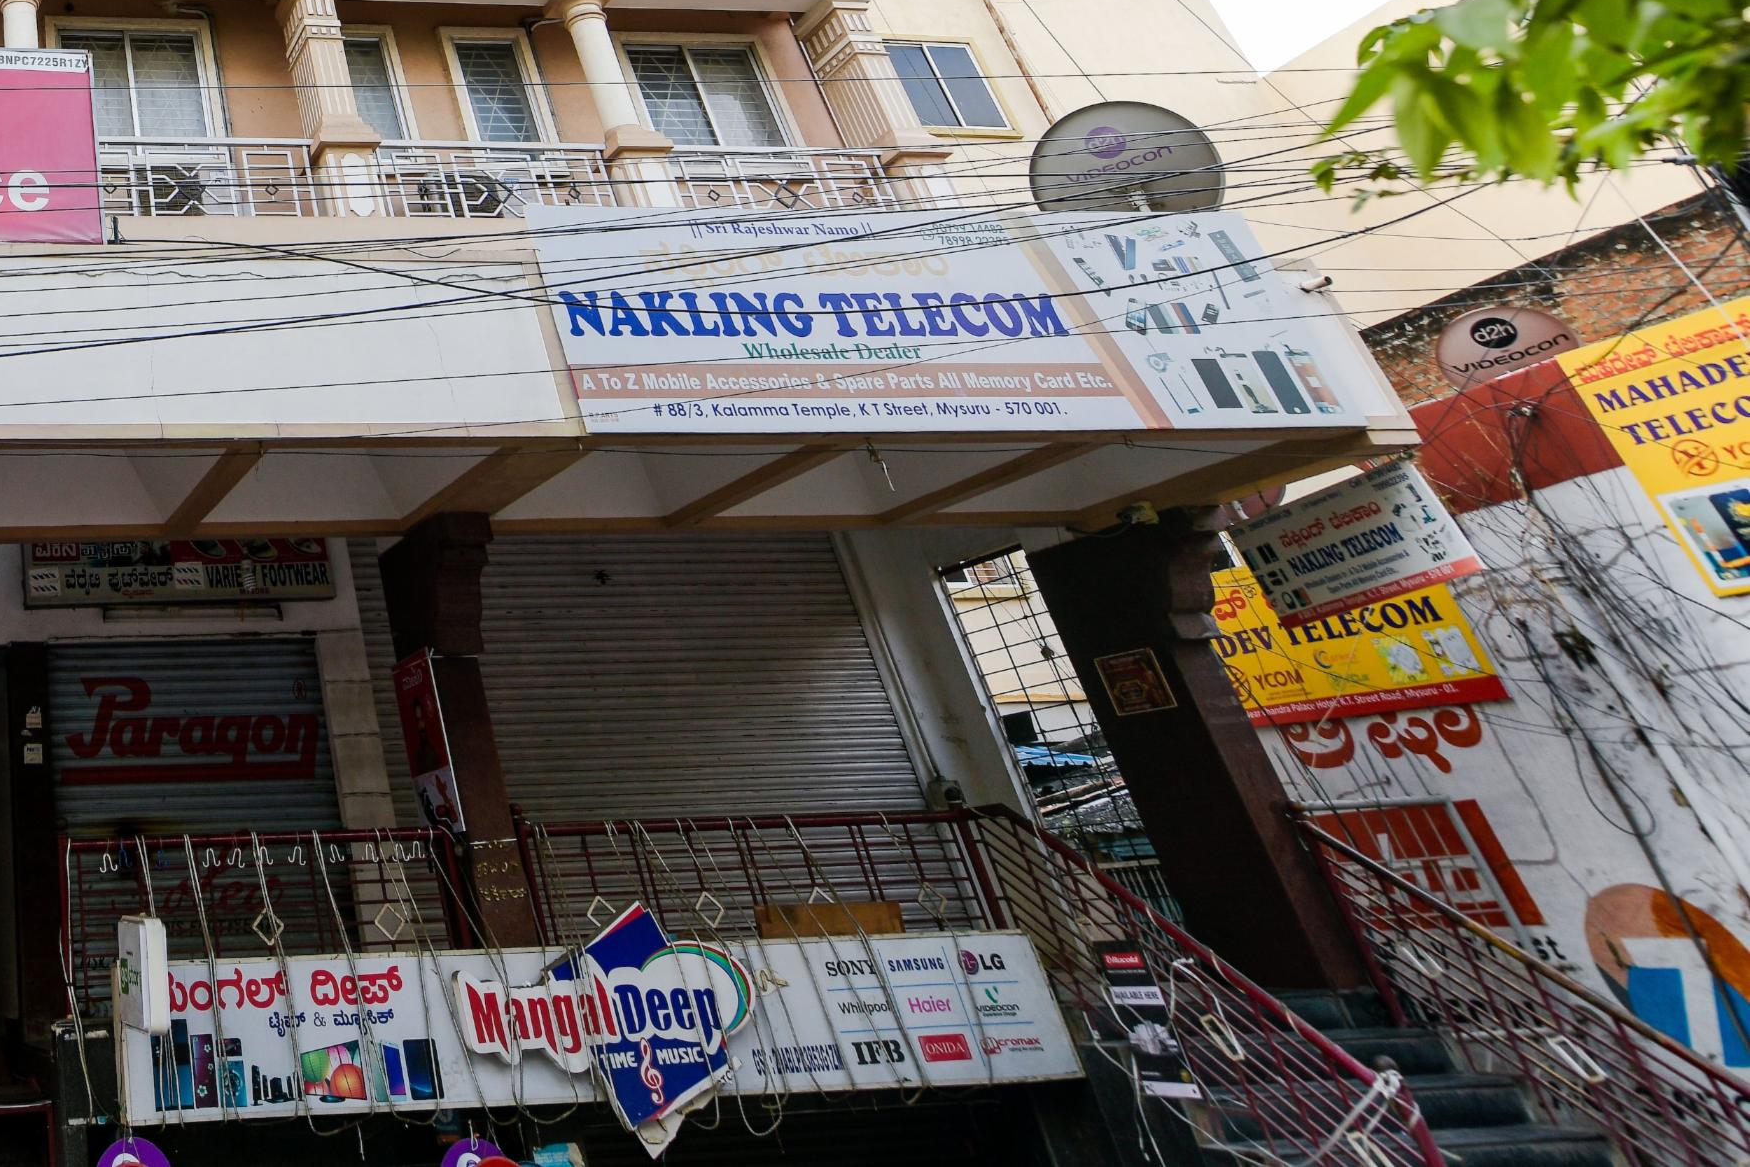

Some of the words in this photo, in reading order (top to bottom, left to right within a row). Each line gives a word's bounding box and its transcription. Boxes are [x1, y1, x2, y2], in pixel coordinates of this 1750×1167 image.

[706, 222, 730, 235] Sri
[732, 221, 810, 239] Rajeshwar
[812, 222, 859, 236] Namo
[558, 289, 817, 339] NAKLING
[818, 290, 1072, 339] TELECOM
[1472, 323, 1515, 343] d2h
[741, 342, 851, 361] Wholesale
[854, 342, 922, 360] Dealer
[1451, 333, 1570, 374] VIDEOCON
[582, 373, 596, 390] A
[598, 373, 621, 390] To
[623, 373, 640, 390] Z
[641, 372, 701, 390] Mobile
[706, 372, 813, 391] Accessories
[816, 373, 831, 390] &
[833, 372, 885, 393] Spare
[886, 372, 934, 391] Parts
[938, 372, 960, 389] All
[962, 371, 1032, 393] Memory
[1034, 371, 1078, 390] Card
[1079, 372, 1114, 389] Etc.
[653, 404, 663, 418] #
[668, 402, 709, 419] 88/3,
[712, 402, 792, 418] Kalamma
[860, 403, 869, 416] K
[872, 403, 881, 416] T
[885, 402, 934, 417] Street,
[937, 403, 991, 418] Mysuru
[1005, 401, 1033, 415] 570
[1286, 541, 1347, 577] NAKLING
[1339, 520, 1405, 559] TELECOM
[205, 564, 257, 588] VARIE
[261, 563, 330, 587] FOOTWEAR
[1278, 595, 1444, 646] TELECOM
[1253, 668, 1305, 692] YCOM
[1355, 692, 1380, 706] Street
[64, 677, 320, 766] Paragon
[825, 958, 877, 977] SONY
[888, 957, 945, 973] SAMSUNG
[981, 953, 1005, 971] LG
[309, 965, 403, 1008] ದೀಪ್
[1113, 989, 1144, 1001] AVAILABLE
[1144, 991, 1160, 1001] HERE
[465, 973, 618, 1056] Mangal
[613, 983, 723, 1048] Deep
[908, 996, 952, 1015] Haier
[976, 1003, 1020, 1012] VIDEOCON
[313, 1012, 327, 1027] &
[599, 1050, 639, 1070] TIME
[655, 1045, 705, 1066] MUSIC
[751, 1049, 767, 1076] GS
[851, 1039, 905, 1065] IFB
[925, 1040, 965, 1055] ONIDA
